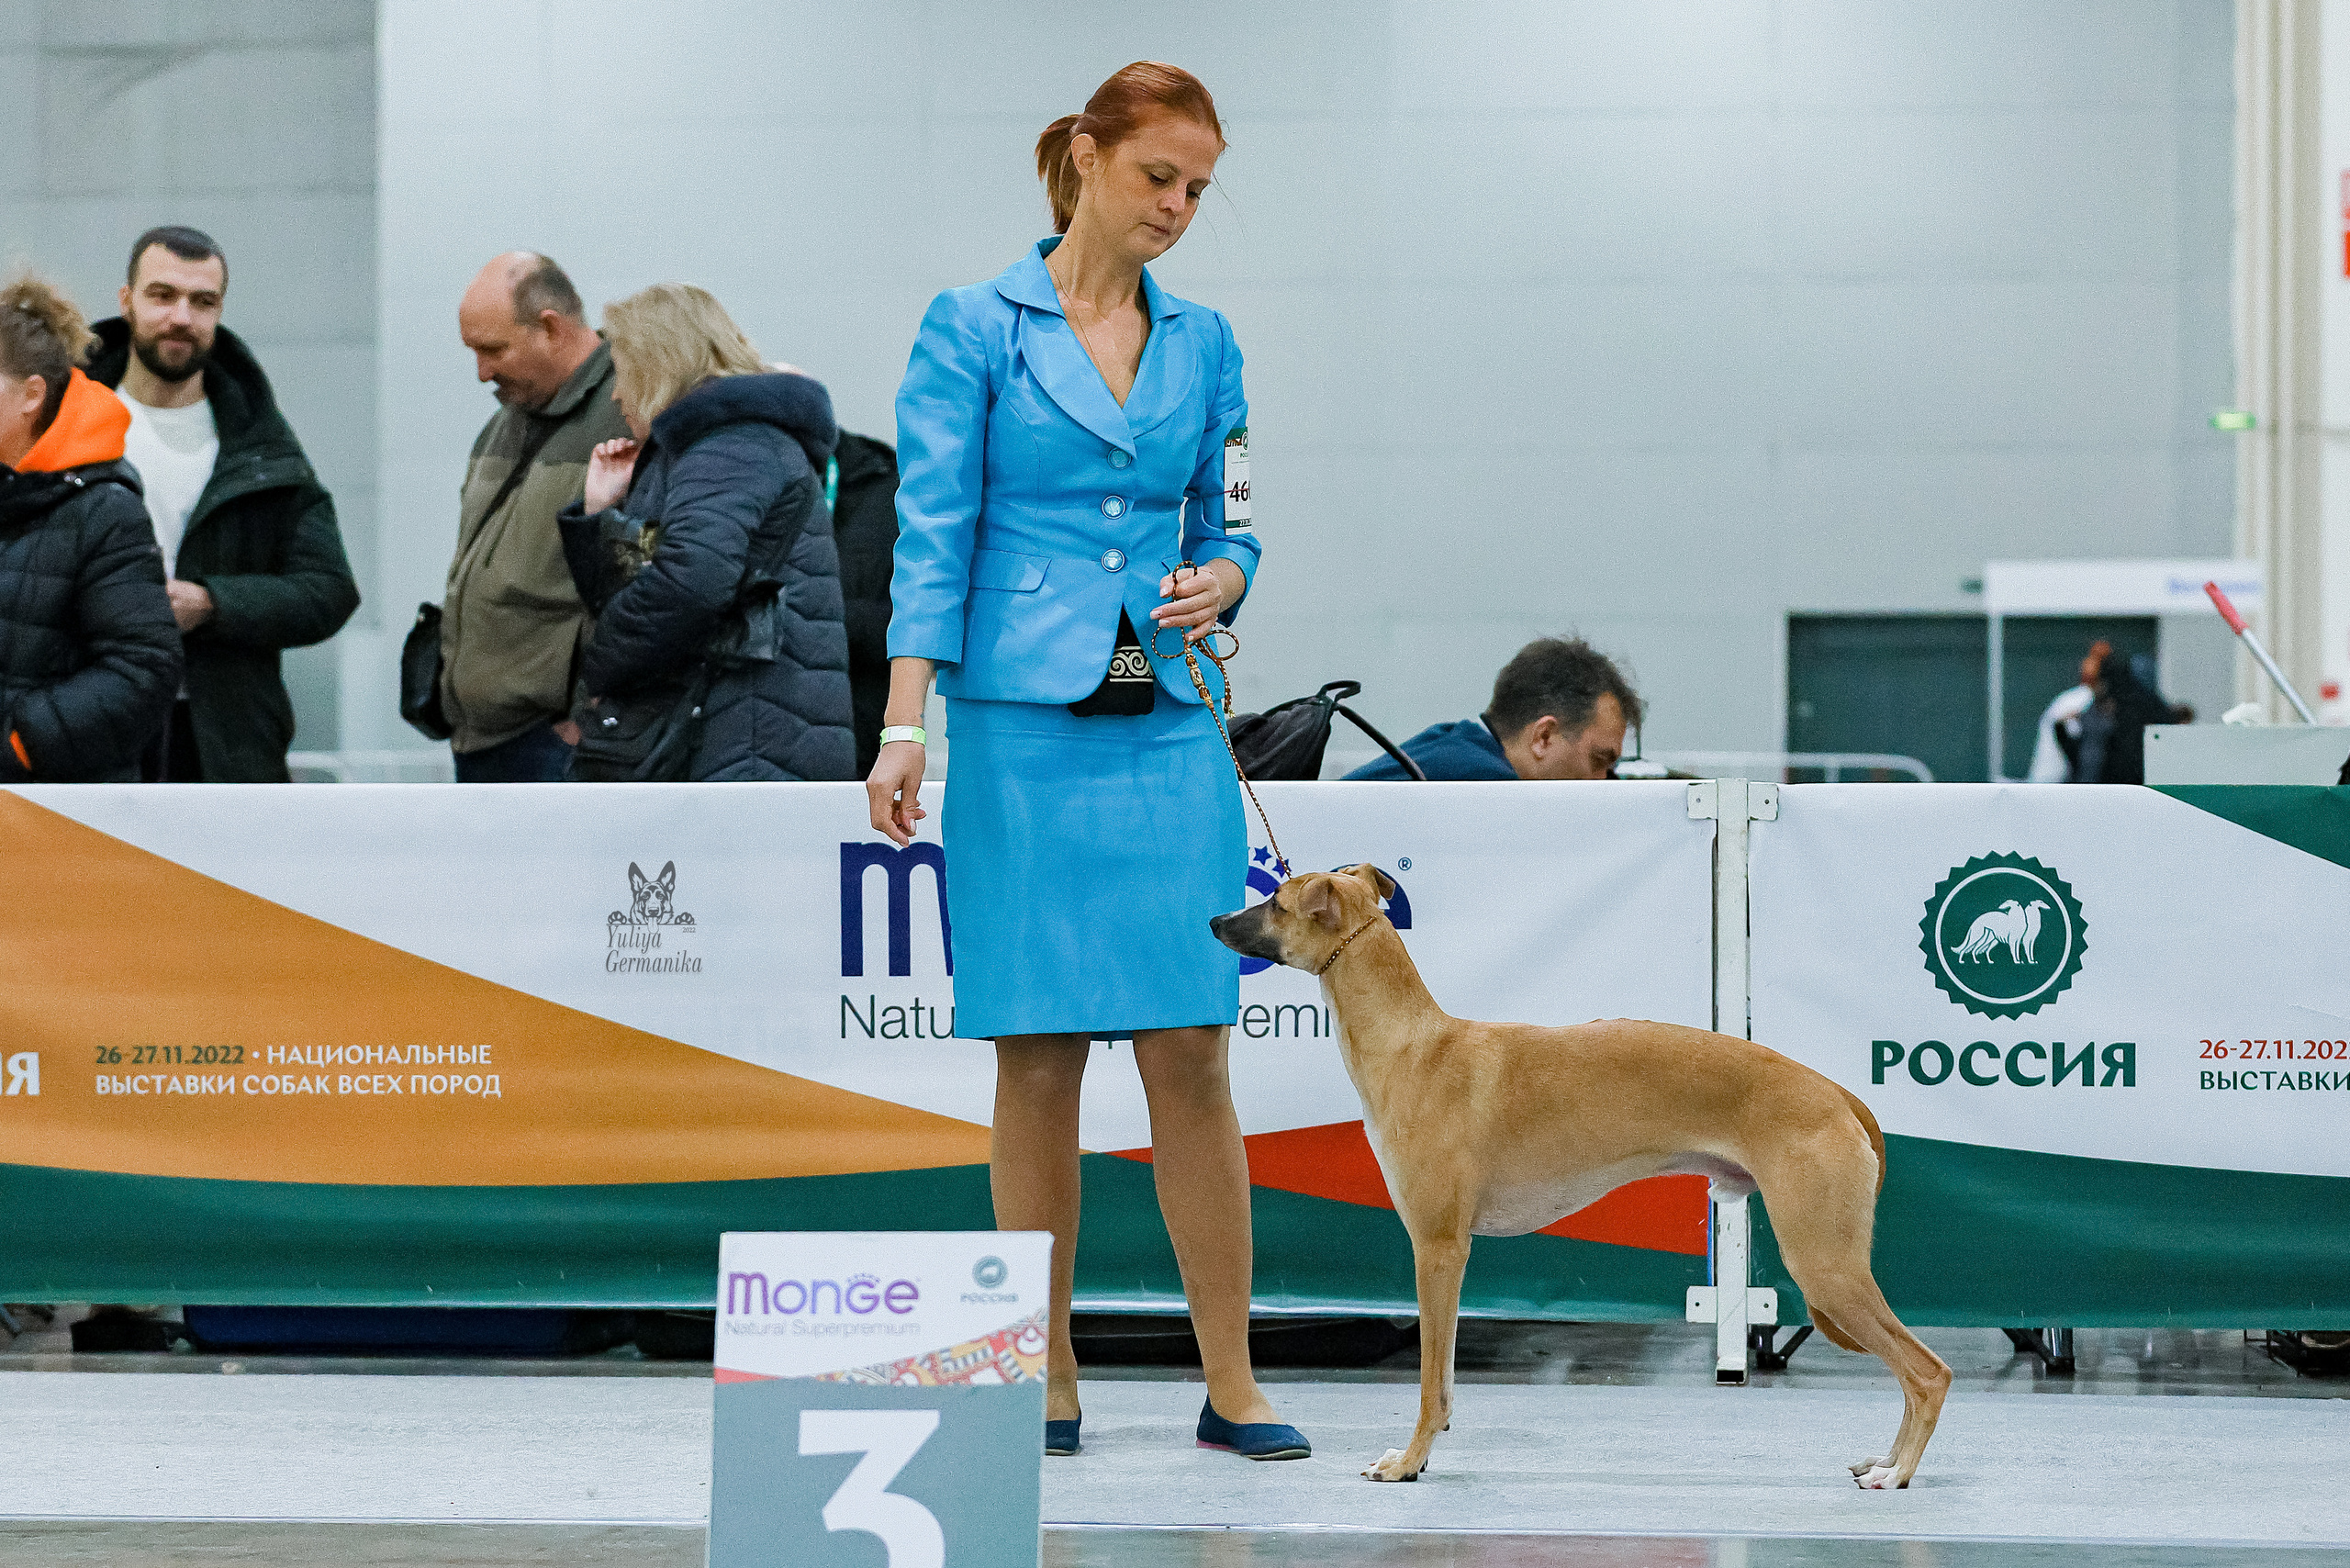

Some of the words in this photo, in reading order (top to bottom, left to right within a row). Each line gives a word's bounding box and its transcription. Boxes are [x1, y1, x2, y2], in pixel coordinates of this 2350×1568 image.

[841, 994, 955, 1039] Natu
[267, 1045, 491, 1068] НАЦИОНАЛЬНЫЕ
[2199, 1039, 2350, 1059] 26-27.11.202
[1871, 1040, 2136, 1087] РОССИЯ
[95, 1075, 235, 1095] ВЫСТАВКИ
[242, 1075, 331, 1095] СОБАК
[339, 1074, 403, 1094] ВСЕХ
[411, 1074, 502, 1099] ПОРОД
[2200, 1070, 2350, 1091] ВЫСТАВКИ
[724, 1319, 787, 1336] Natural
[798, 1409, 946, 1568] 3
